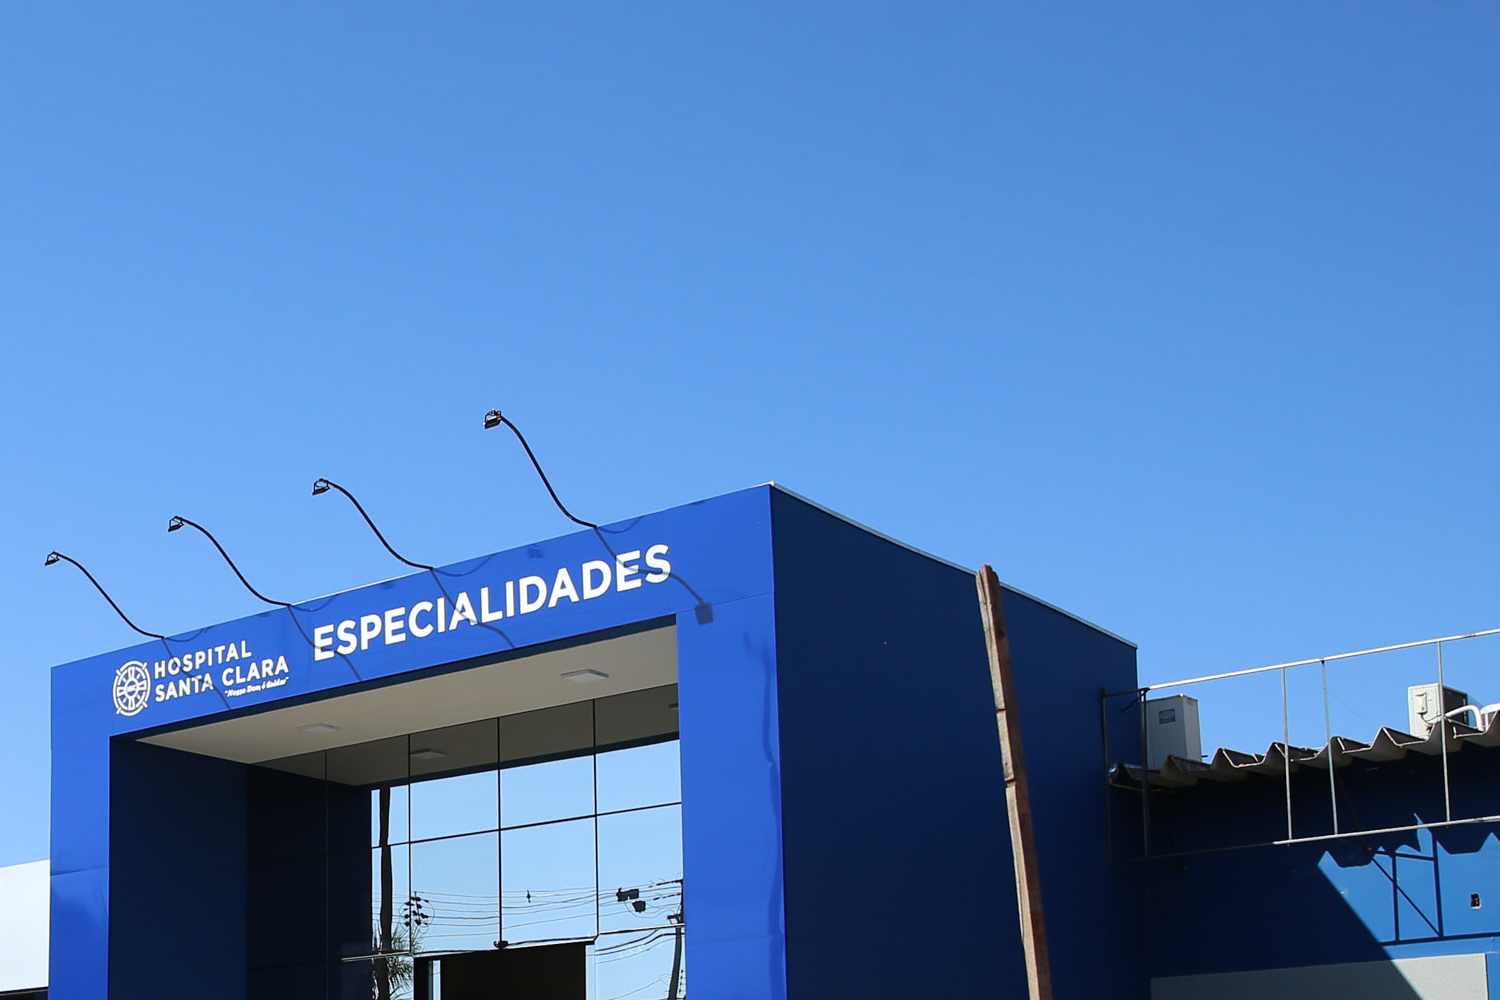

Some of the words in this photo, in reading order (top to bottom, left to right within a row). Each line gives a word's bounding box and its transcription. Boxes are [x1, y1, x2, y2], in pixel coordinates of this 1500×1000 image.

[313, 544, 671, 662] ESPECIALIDADES
[154, 640, 253, 679] HOSPITAL
[155, 673, 215, 702] SANTA
[221, 656, 289, 687] CLARA
